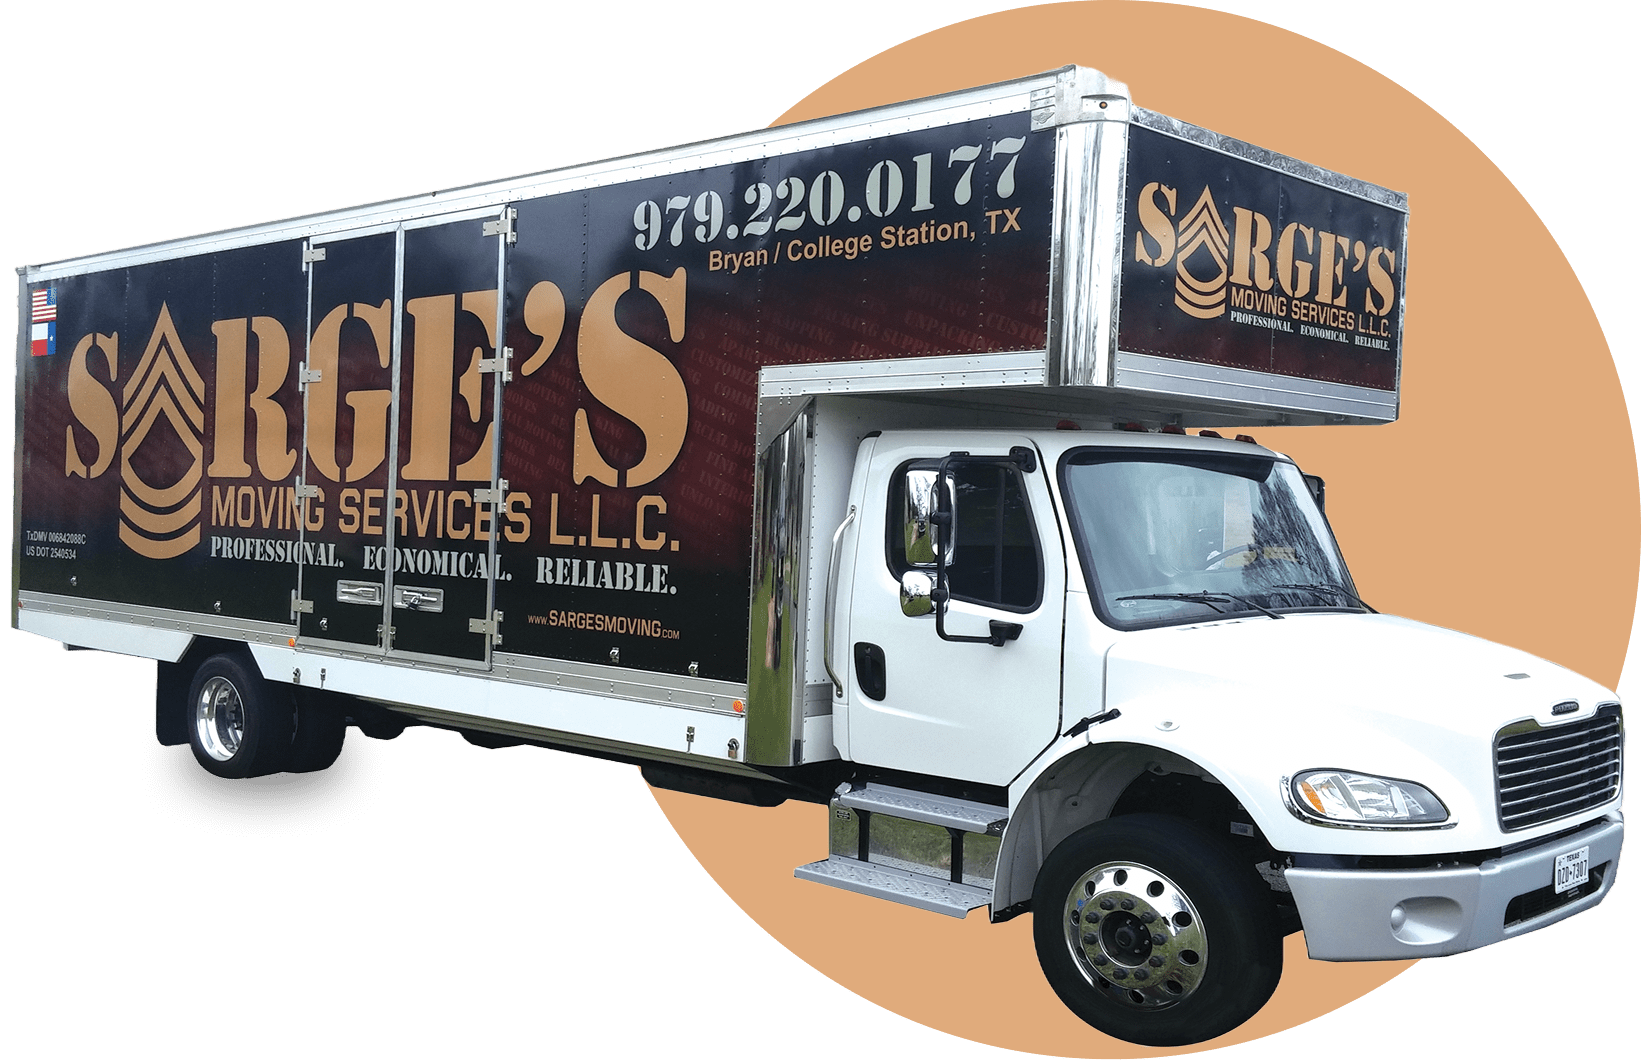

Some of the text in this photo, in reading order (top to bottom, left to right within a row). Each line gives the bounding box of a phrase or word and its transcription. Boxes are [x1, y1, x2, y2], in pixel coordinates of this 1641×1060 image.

[633, 135, 1027, 251] 979.220.0177
[708, 207, 1022, 274] Bryan / College Station, TX
[1230, 311, 1391, 351] PROFESSIONAL. ECONOMICAL. RELIABLE.
[1231, 286, 1391, 338] MOVING SERVICES L.L.C.
[26, 530, 48, 542] TxDMV
[211, 485, 680, 552] MOVING SERVICES L.L.C.
[26, 545, 77, 560] US DOT 2540534
[210, 535, 678, 595] PROFESSIONAL. ECONOMICAL. RELIABLE.
[1566, 851, 1580, 862] TEXAS
